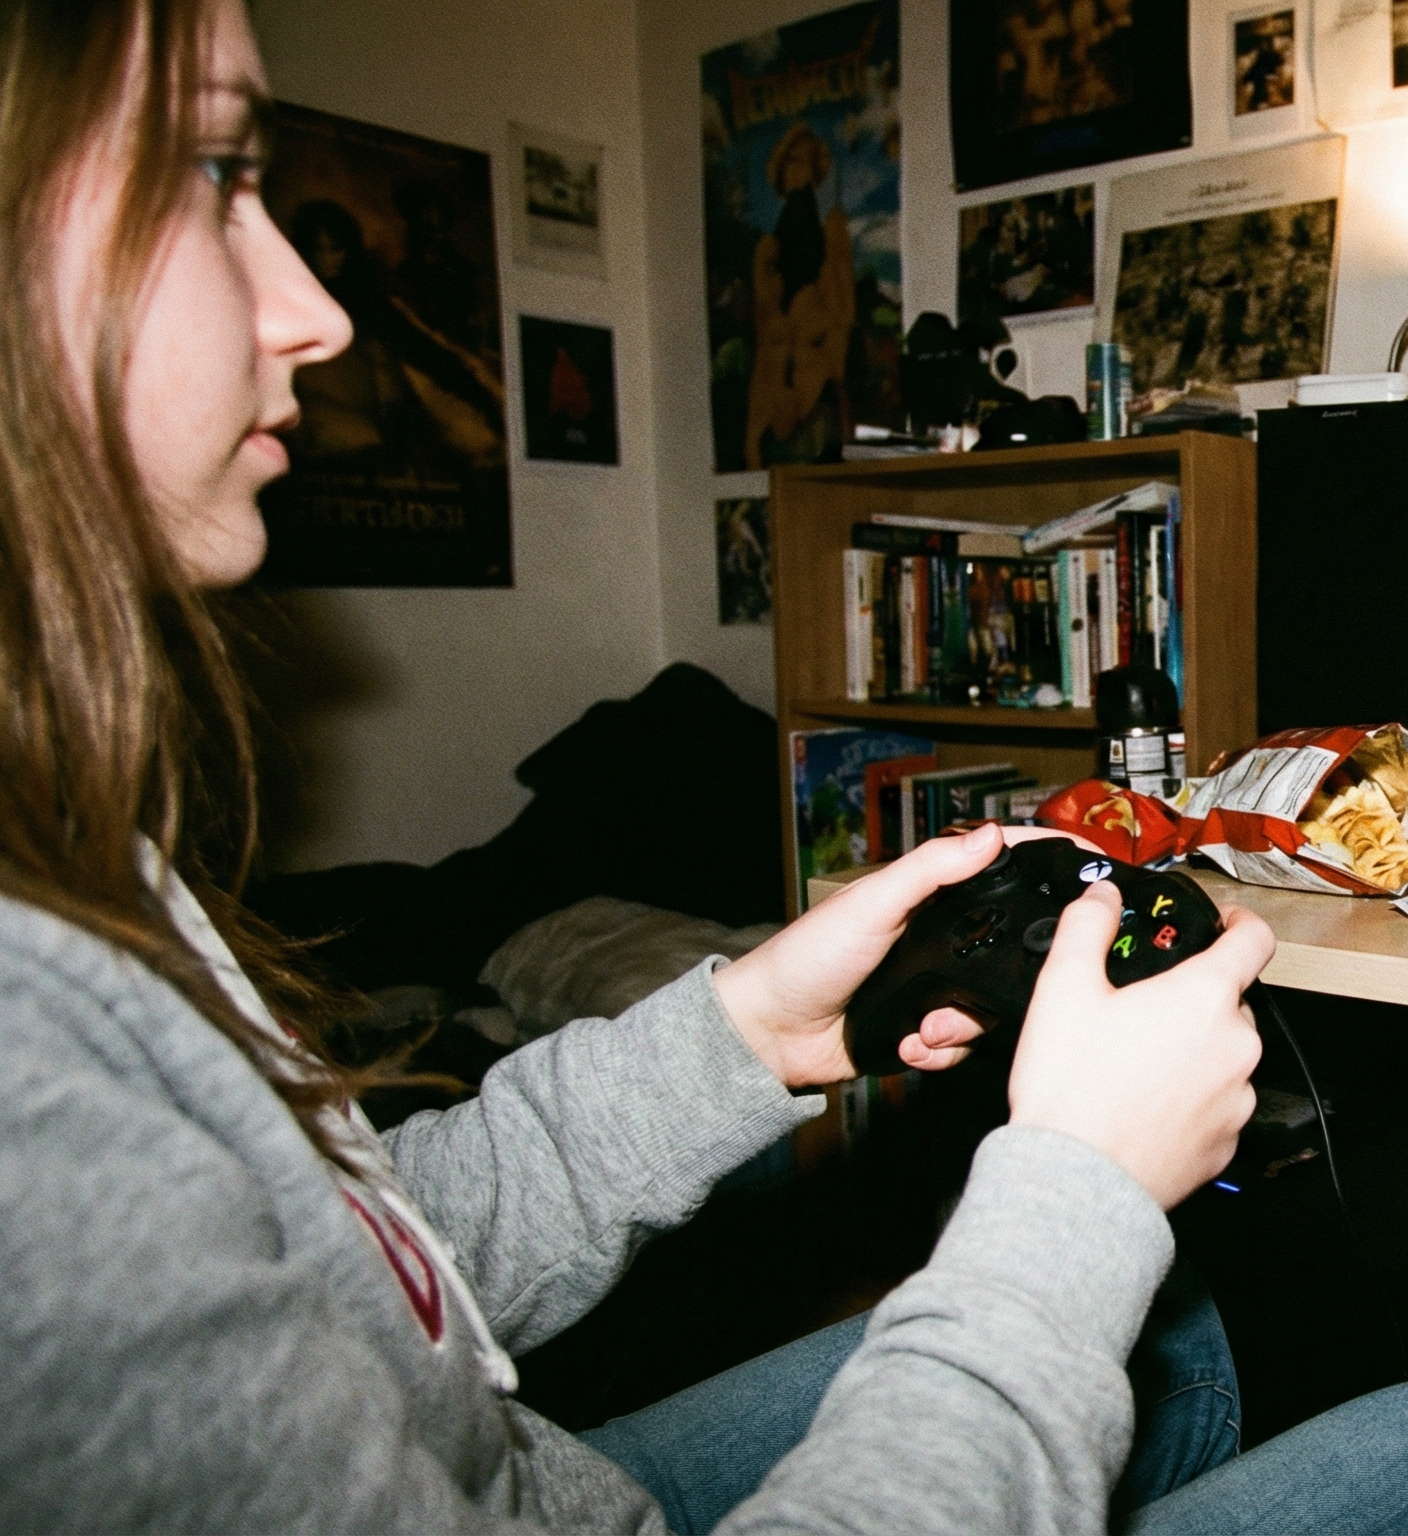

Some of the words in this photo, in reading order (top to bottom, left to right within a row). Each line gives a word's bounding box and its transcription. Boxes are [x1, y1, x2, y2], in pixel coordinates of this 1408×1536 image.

[1151, 895, 1174, 917] Y
[1113, 935, 1133, 958] A
[1152, 924, 1178, 951] B
